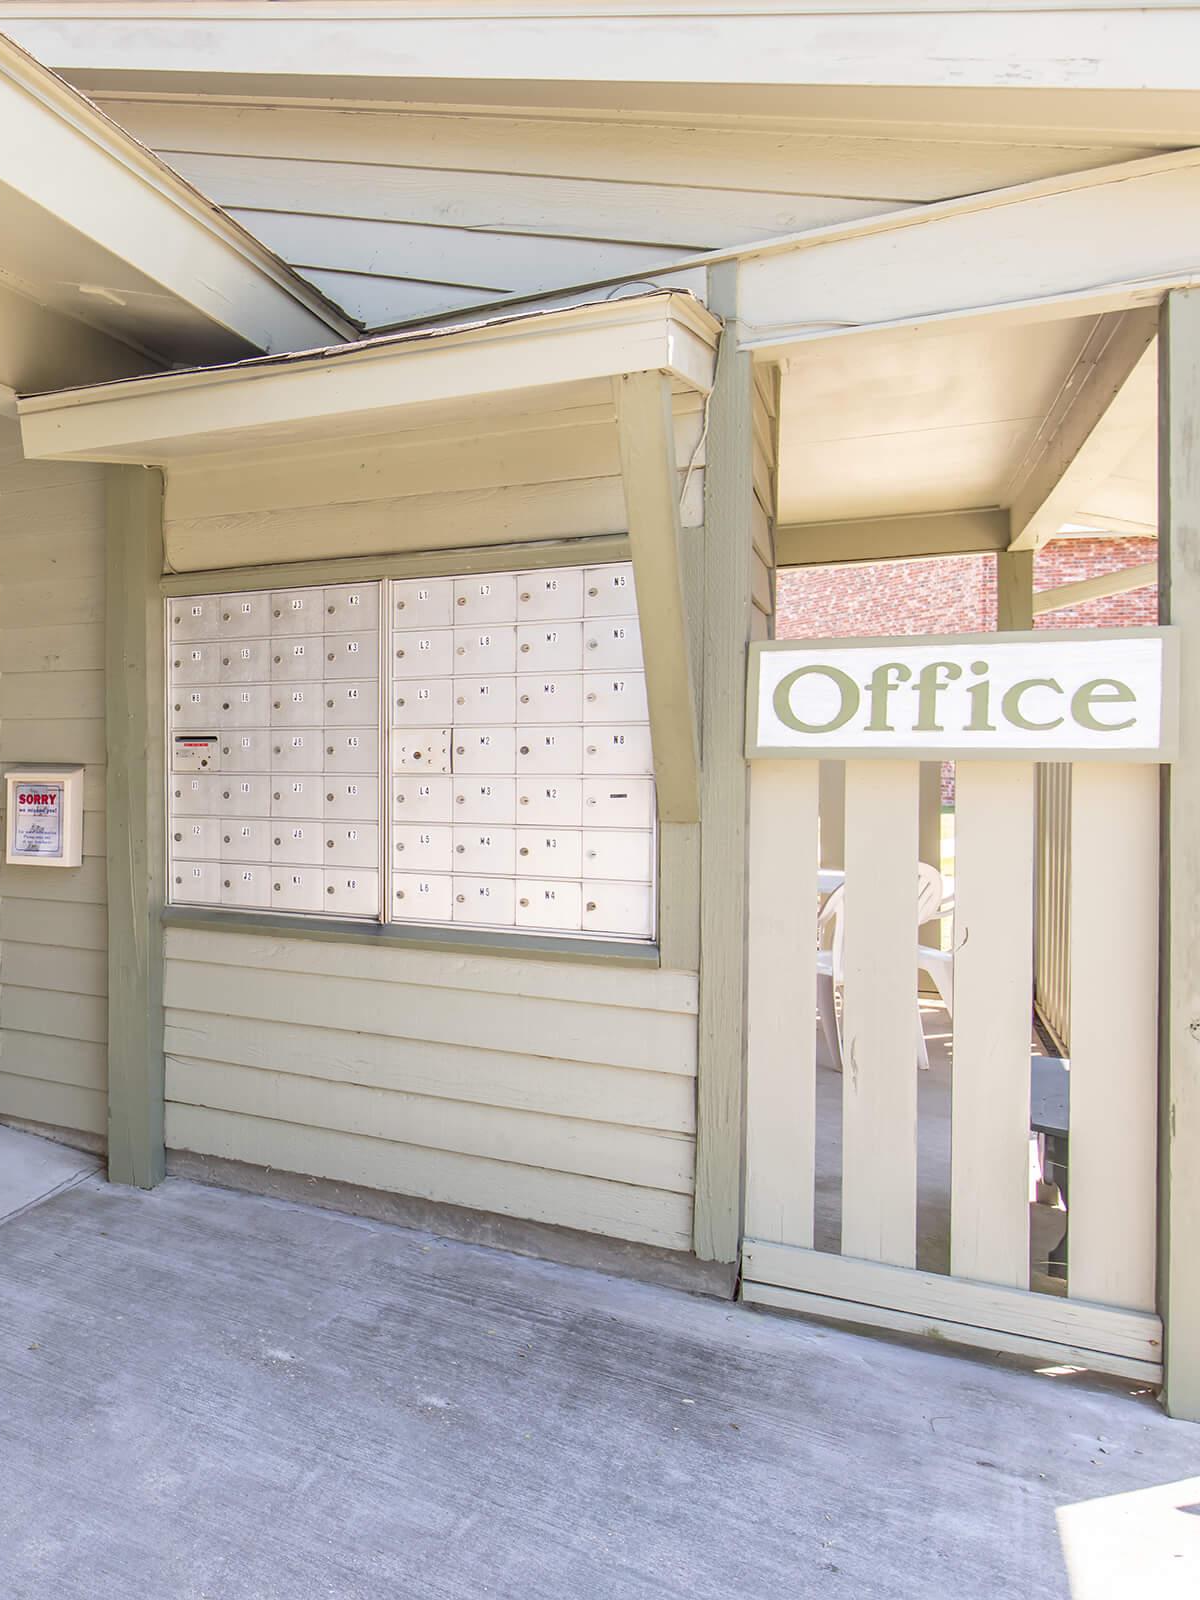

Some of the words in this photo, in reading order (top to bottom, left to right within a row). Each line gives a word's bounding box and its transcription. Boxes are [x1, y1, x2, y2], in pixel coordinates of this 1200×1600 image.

[615, 577, 625, 586] N5
[418, 591, 428, 600] L1
[480, 586, 490, 595] L7
[614, 629, 624, 639] N6
[420, 640, 430, 650] L2
[480, 636, 490, 646] L8
[614, 682, 624, 692] N7
[419, 690, 429, 699] L3
[773, 661, 1137, 734] Office
[545, 736, 555, 746] N1
[614, 735, 624, 745] N8
[420, 786, 430, 796] L4
[546, 789, 556, 798] N2
[18, 794, 56, 805] SORRY
[420, 834, 430, 844] L5
[546, 839, 556, 848] N3
[419, 883, 429, 893] L6
[545, 891, 555, 900] N4
